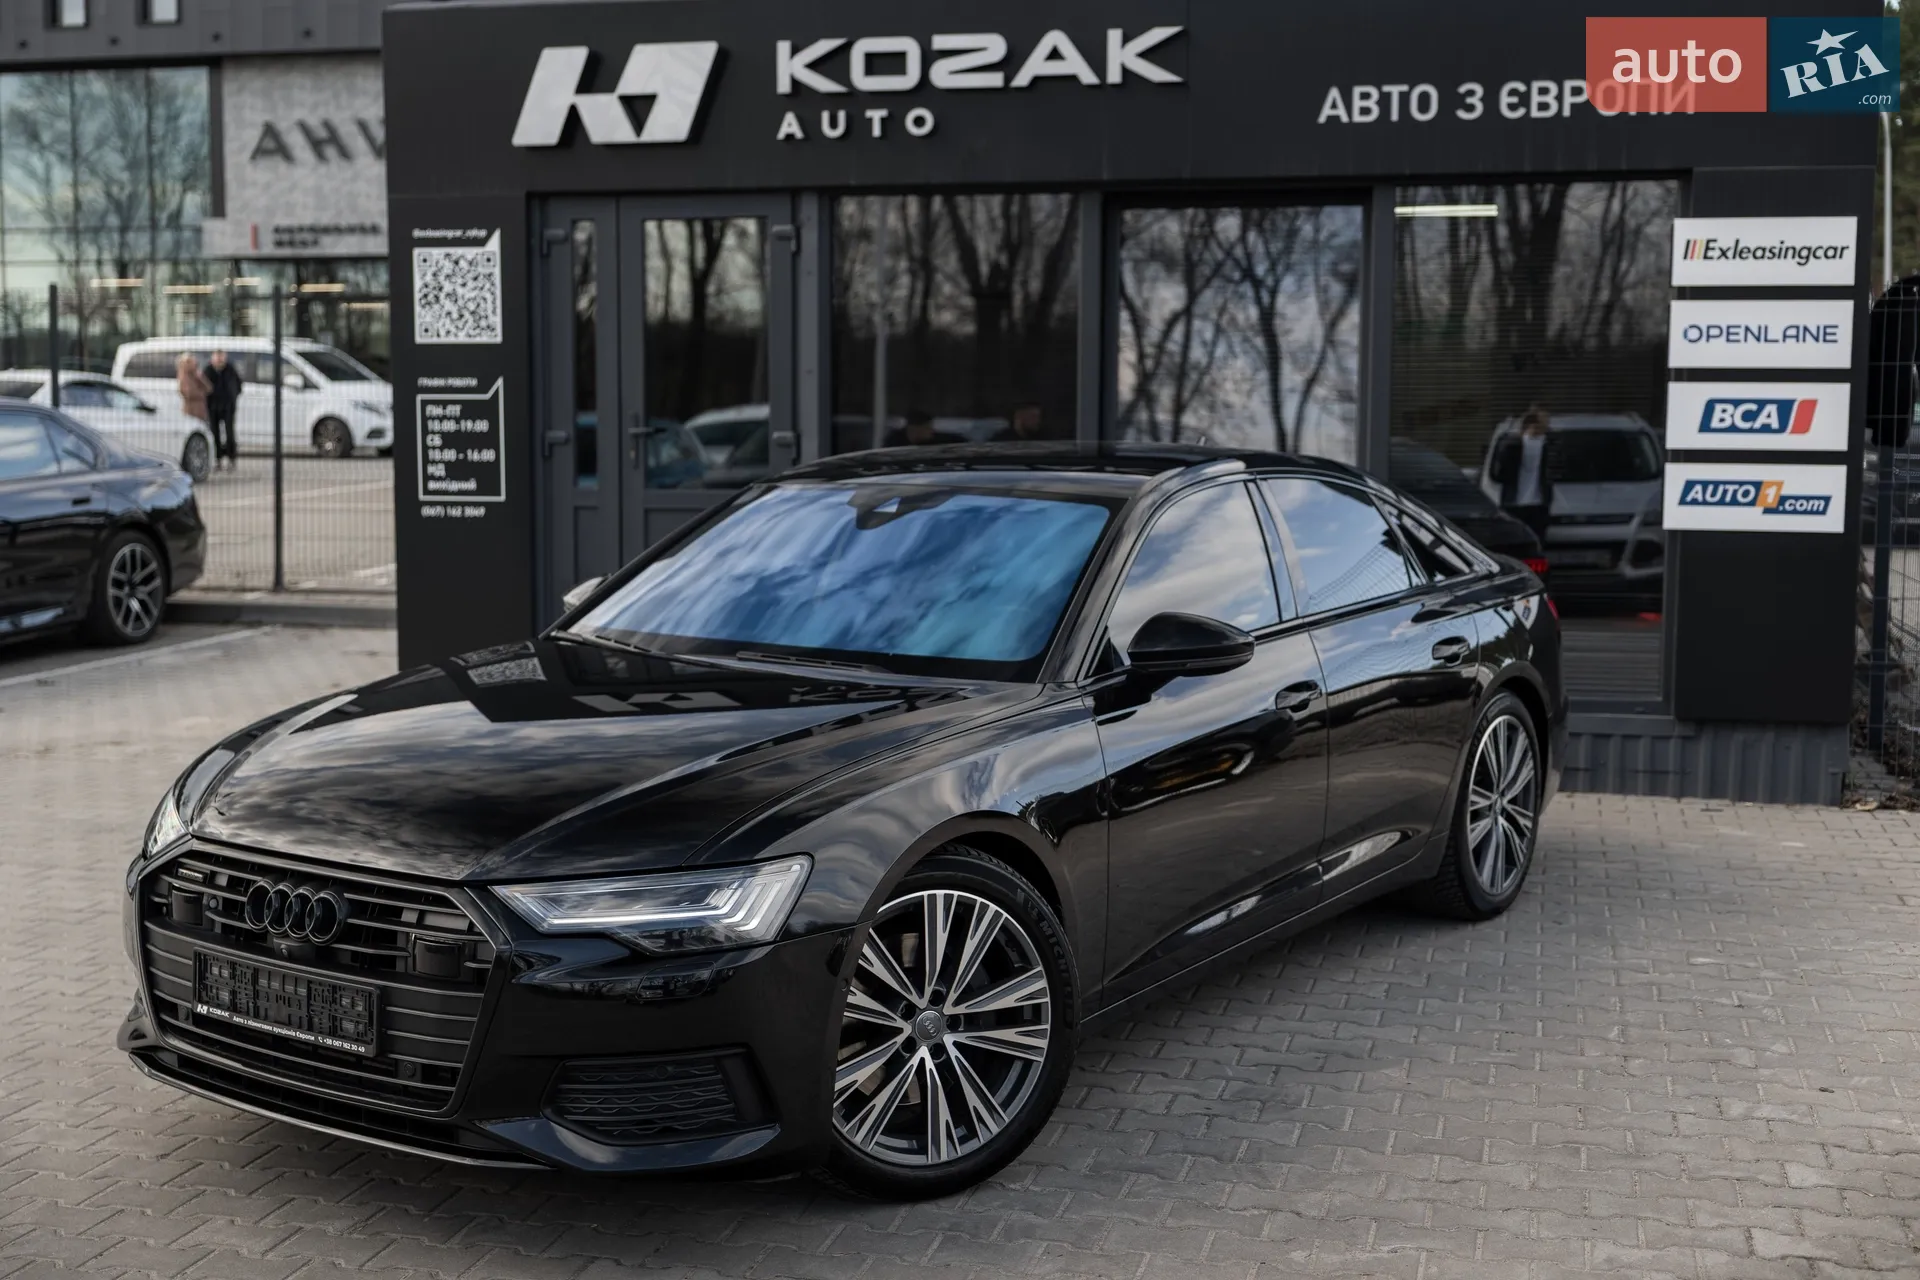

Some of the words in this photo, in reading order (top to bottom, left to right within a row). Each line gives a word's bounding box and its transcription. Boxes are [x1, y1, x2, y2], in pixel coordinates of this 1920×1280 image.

[777, 26, 1182, 93] KOZAK
[1317, 84, 1439, 123] АВТО
[1456, 82, 1484, 120] З
[1498, 79, 1697, 119] ЄВРОПИ
[777, 107, 934, 140] AUTO
[1703, 238, 1850, 266] Exleasingcar
[1683, 324, 1839, 344] OPENLANE
[1710, 403, 1780, 429] BCA
[426, 434, 443, 447] СБ
